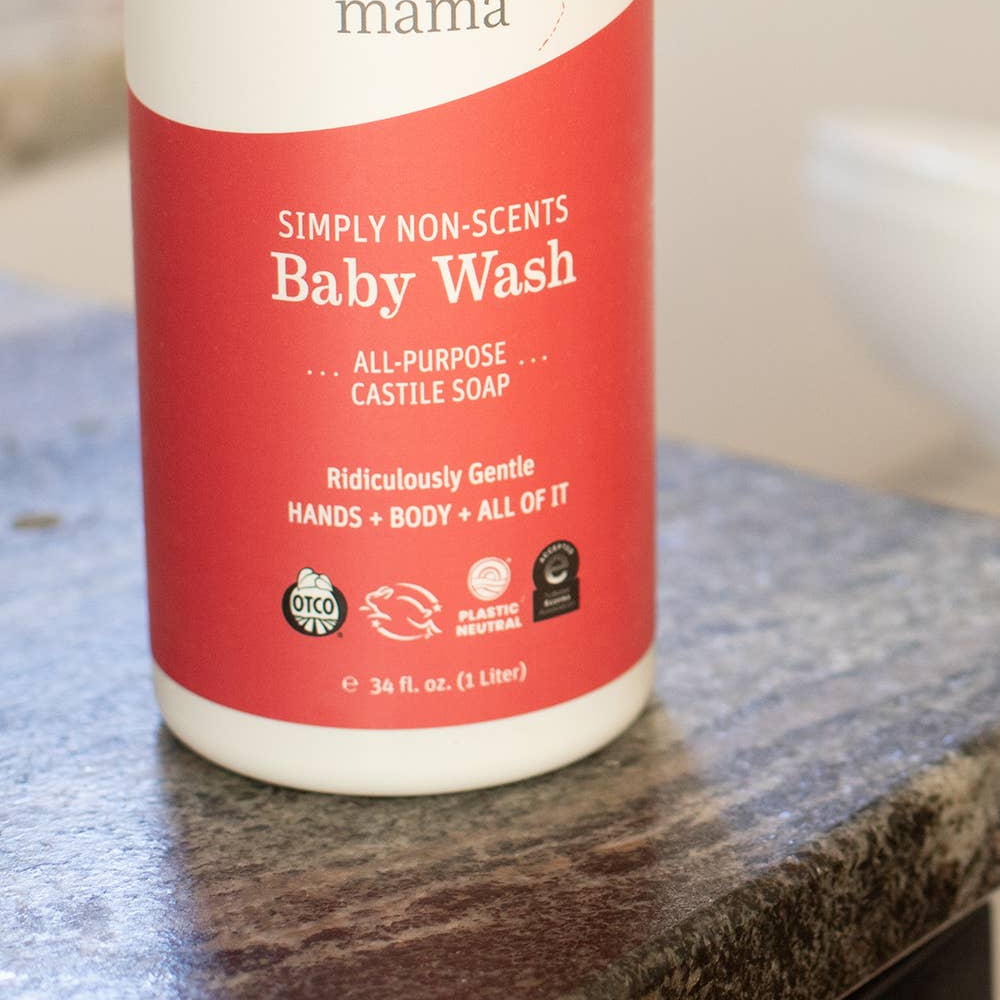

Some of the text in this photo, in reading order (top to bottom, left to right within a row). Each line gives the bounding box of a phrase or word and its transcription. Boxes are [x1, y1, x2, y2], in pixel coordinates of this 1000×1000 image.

[278, 194, 569, 243] SIMPLY NON-SCENTS
[270, 238, 577, 319] Baby Wash
[353, 341, 507, 373] ALL-PURPOSE
[351, 373, 510, 406] CASTILE SOAP
[327, 455, 535, 492] Ridiculously Gentle
[288, 501, 362, 528] HANDS
[390, 504, 451, 528] BODY
[477, 496, 514, 521] ALL
[520, 488, 546, 514] OF
[551, 482, 569, 507] IT
[293, 595, 334, 615] OTCO
[458, 602, 520, 622] PLASTIC
[456, 616, 523, 637] NEUTRAL
[370, 677, 394, 695] 34
[399, 675, 420, 693] fl.
[424, 677, 452, 692] oz.
[456, 670, 475, 692] (1
[480, 661, 528, 687] Liter)
